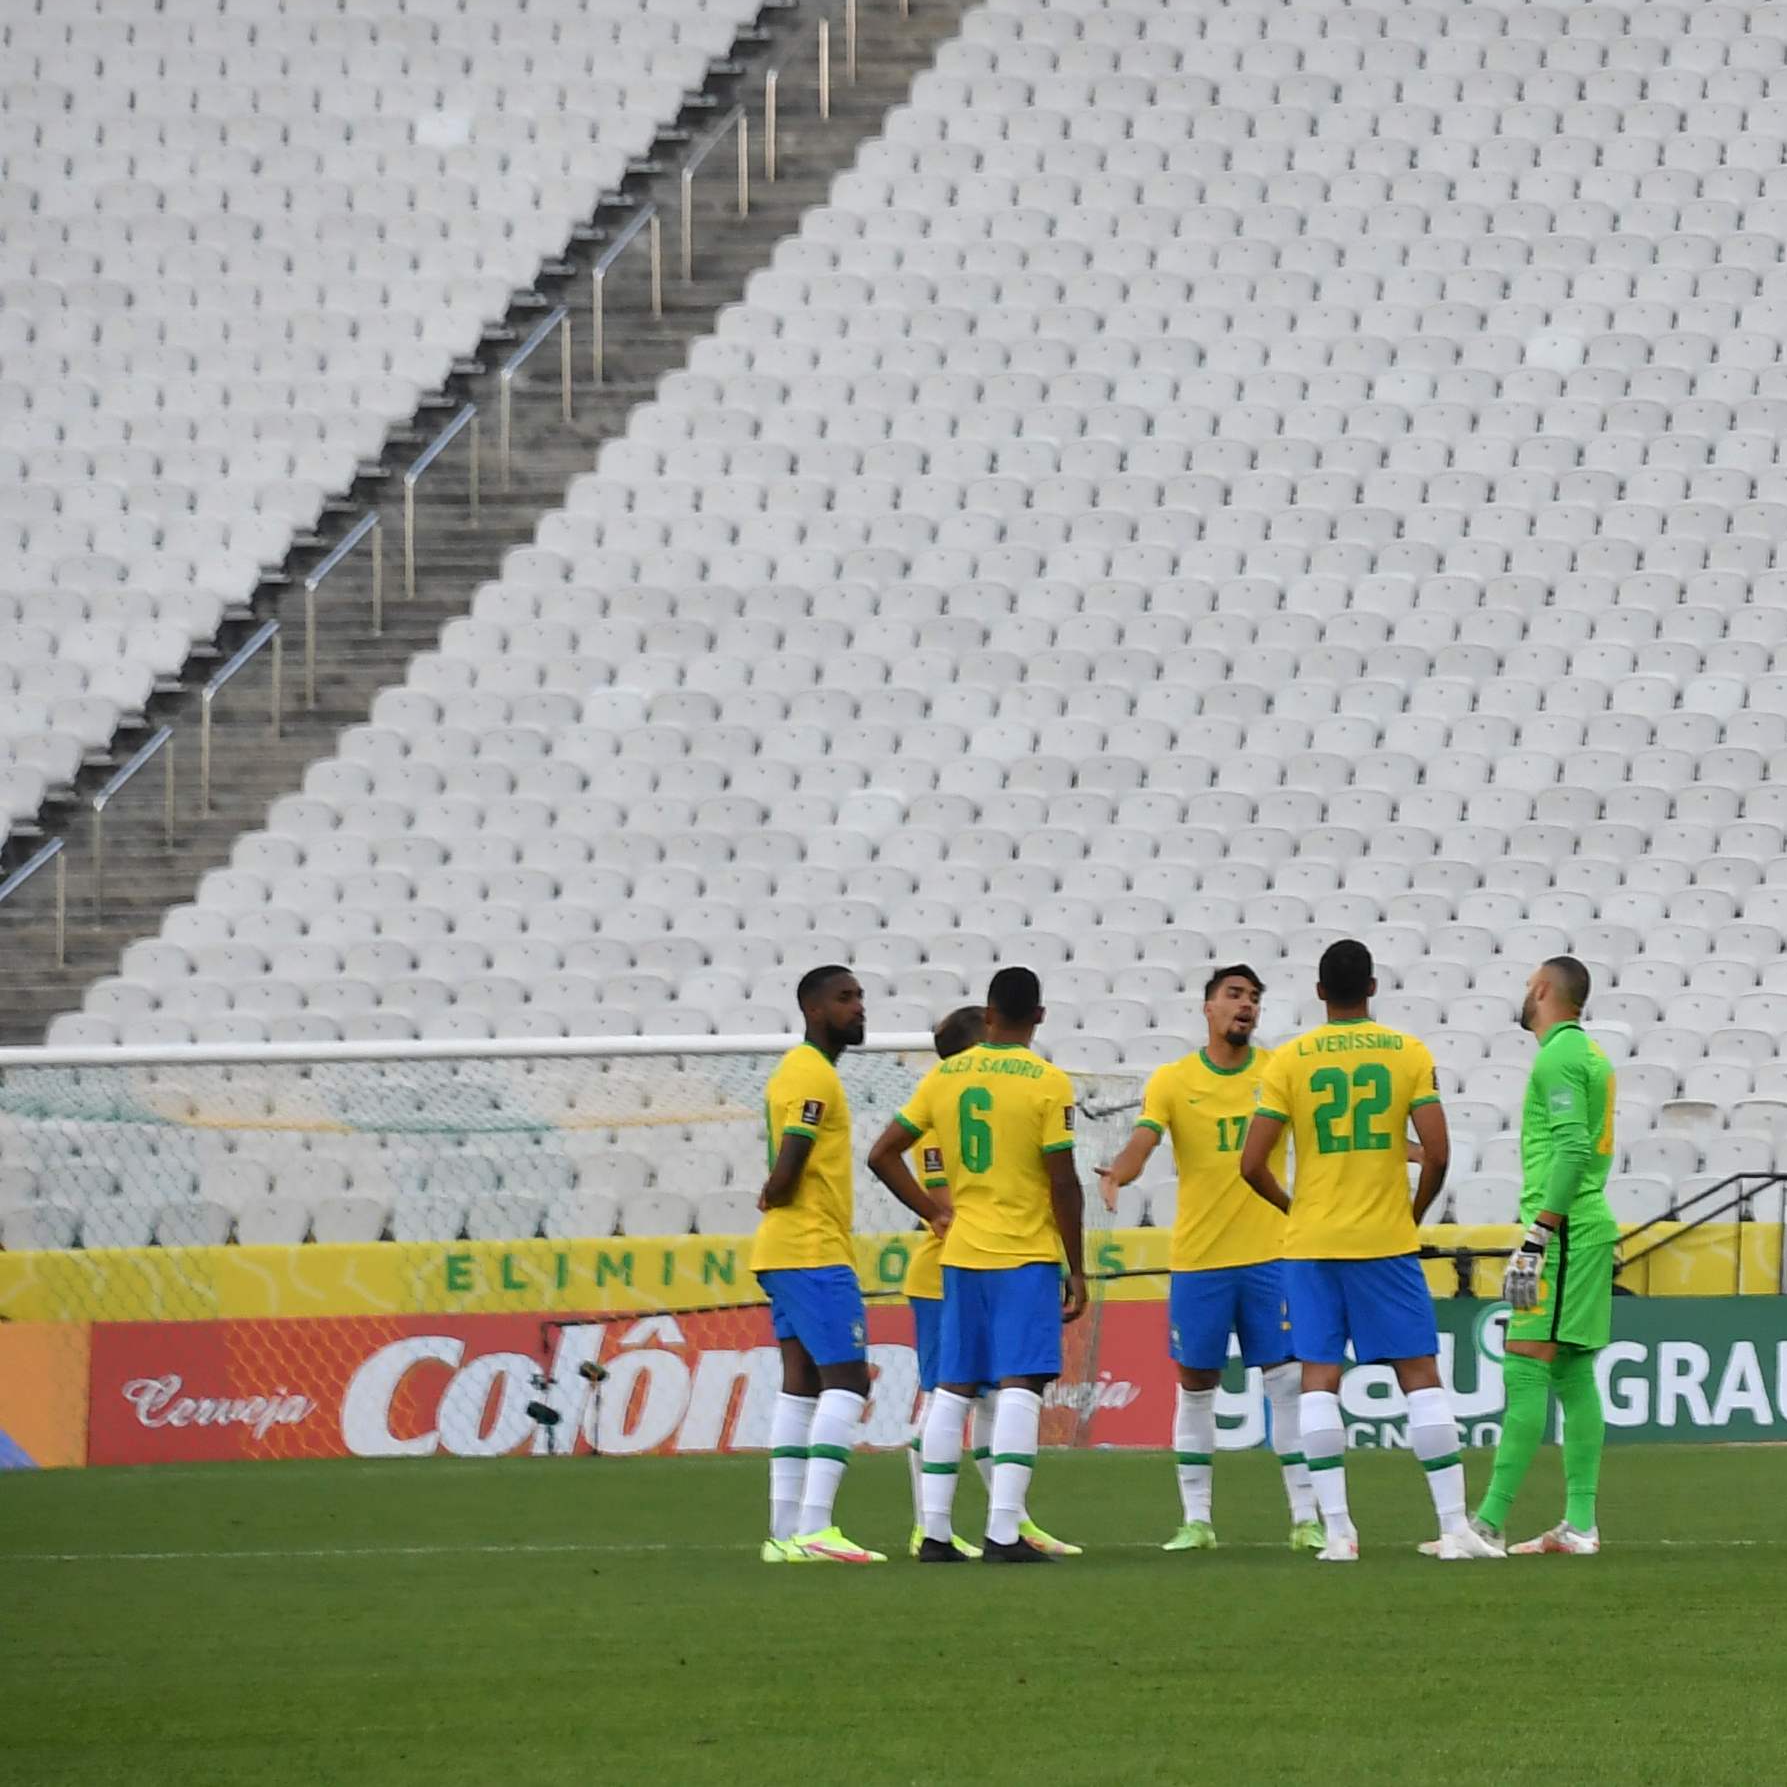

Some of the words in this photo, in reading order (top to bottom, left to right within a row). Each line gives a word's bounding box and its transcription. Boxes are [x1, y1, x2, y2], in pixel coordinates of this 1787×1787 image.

[958, 1086, 993, 1174] 6
[1216, 1115, 1249, 1152] 17
[1310, 1063, 1392, 1155] 22
[122, 1373, 318, 1440] Cerveja
